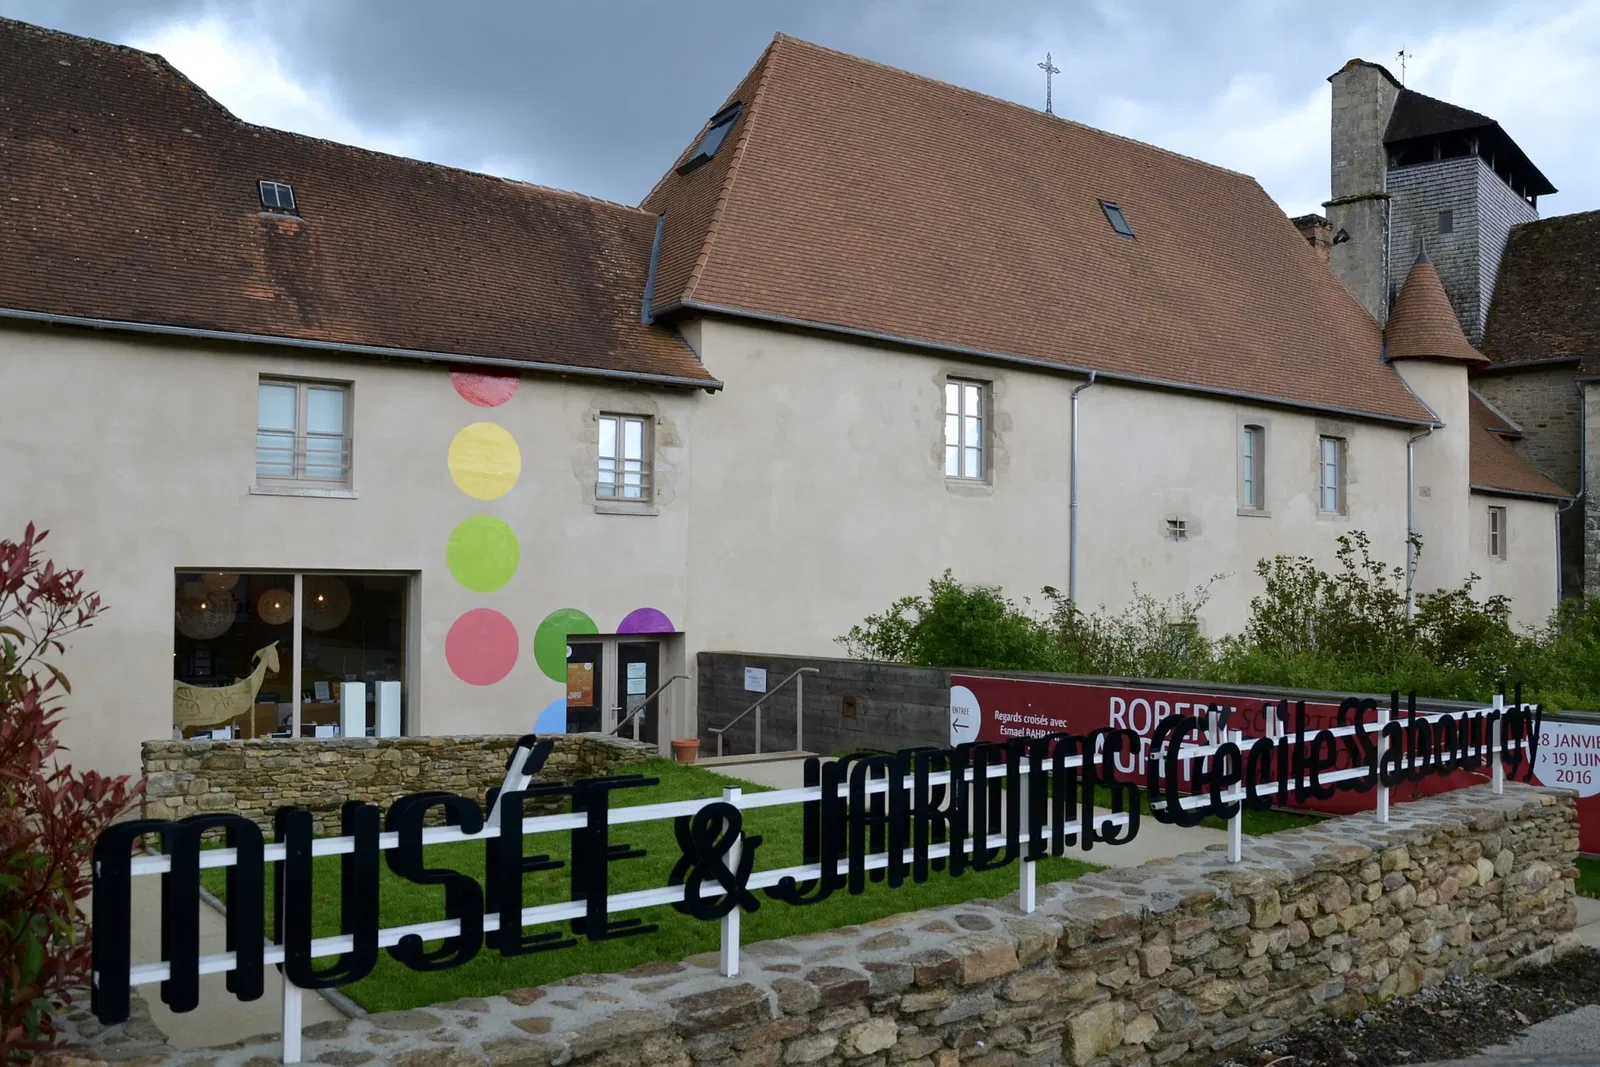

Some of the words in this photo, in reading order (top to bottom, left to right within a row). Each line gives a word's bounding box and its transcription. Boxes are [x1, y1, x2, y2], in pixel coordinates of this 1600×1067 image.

[952, 706, 969, 716] ENTRÉE
[994, 710, 1022, 724] Regards
[1023, 715, 1048, 726] croisés
[1050, 719, 1067, 728] avec
[1000, 725, 1024, 737] Esmael
[1026, 728, 1060, 741] BAHR
[1552, 752, 1567, 766] 19
[1556, 769, 1592, 784] 2016
[92, 735, 659, 1024] MUSÉE
[669, 801, 763, 920] &
[1335, 681, 1542, 793] Sabourdy
